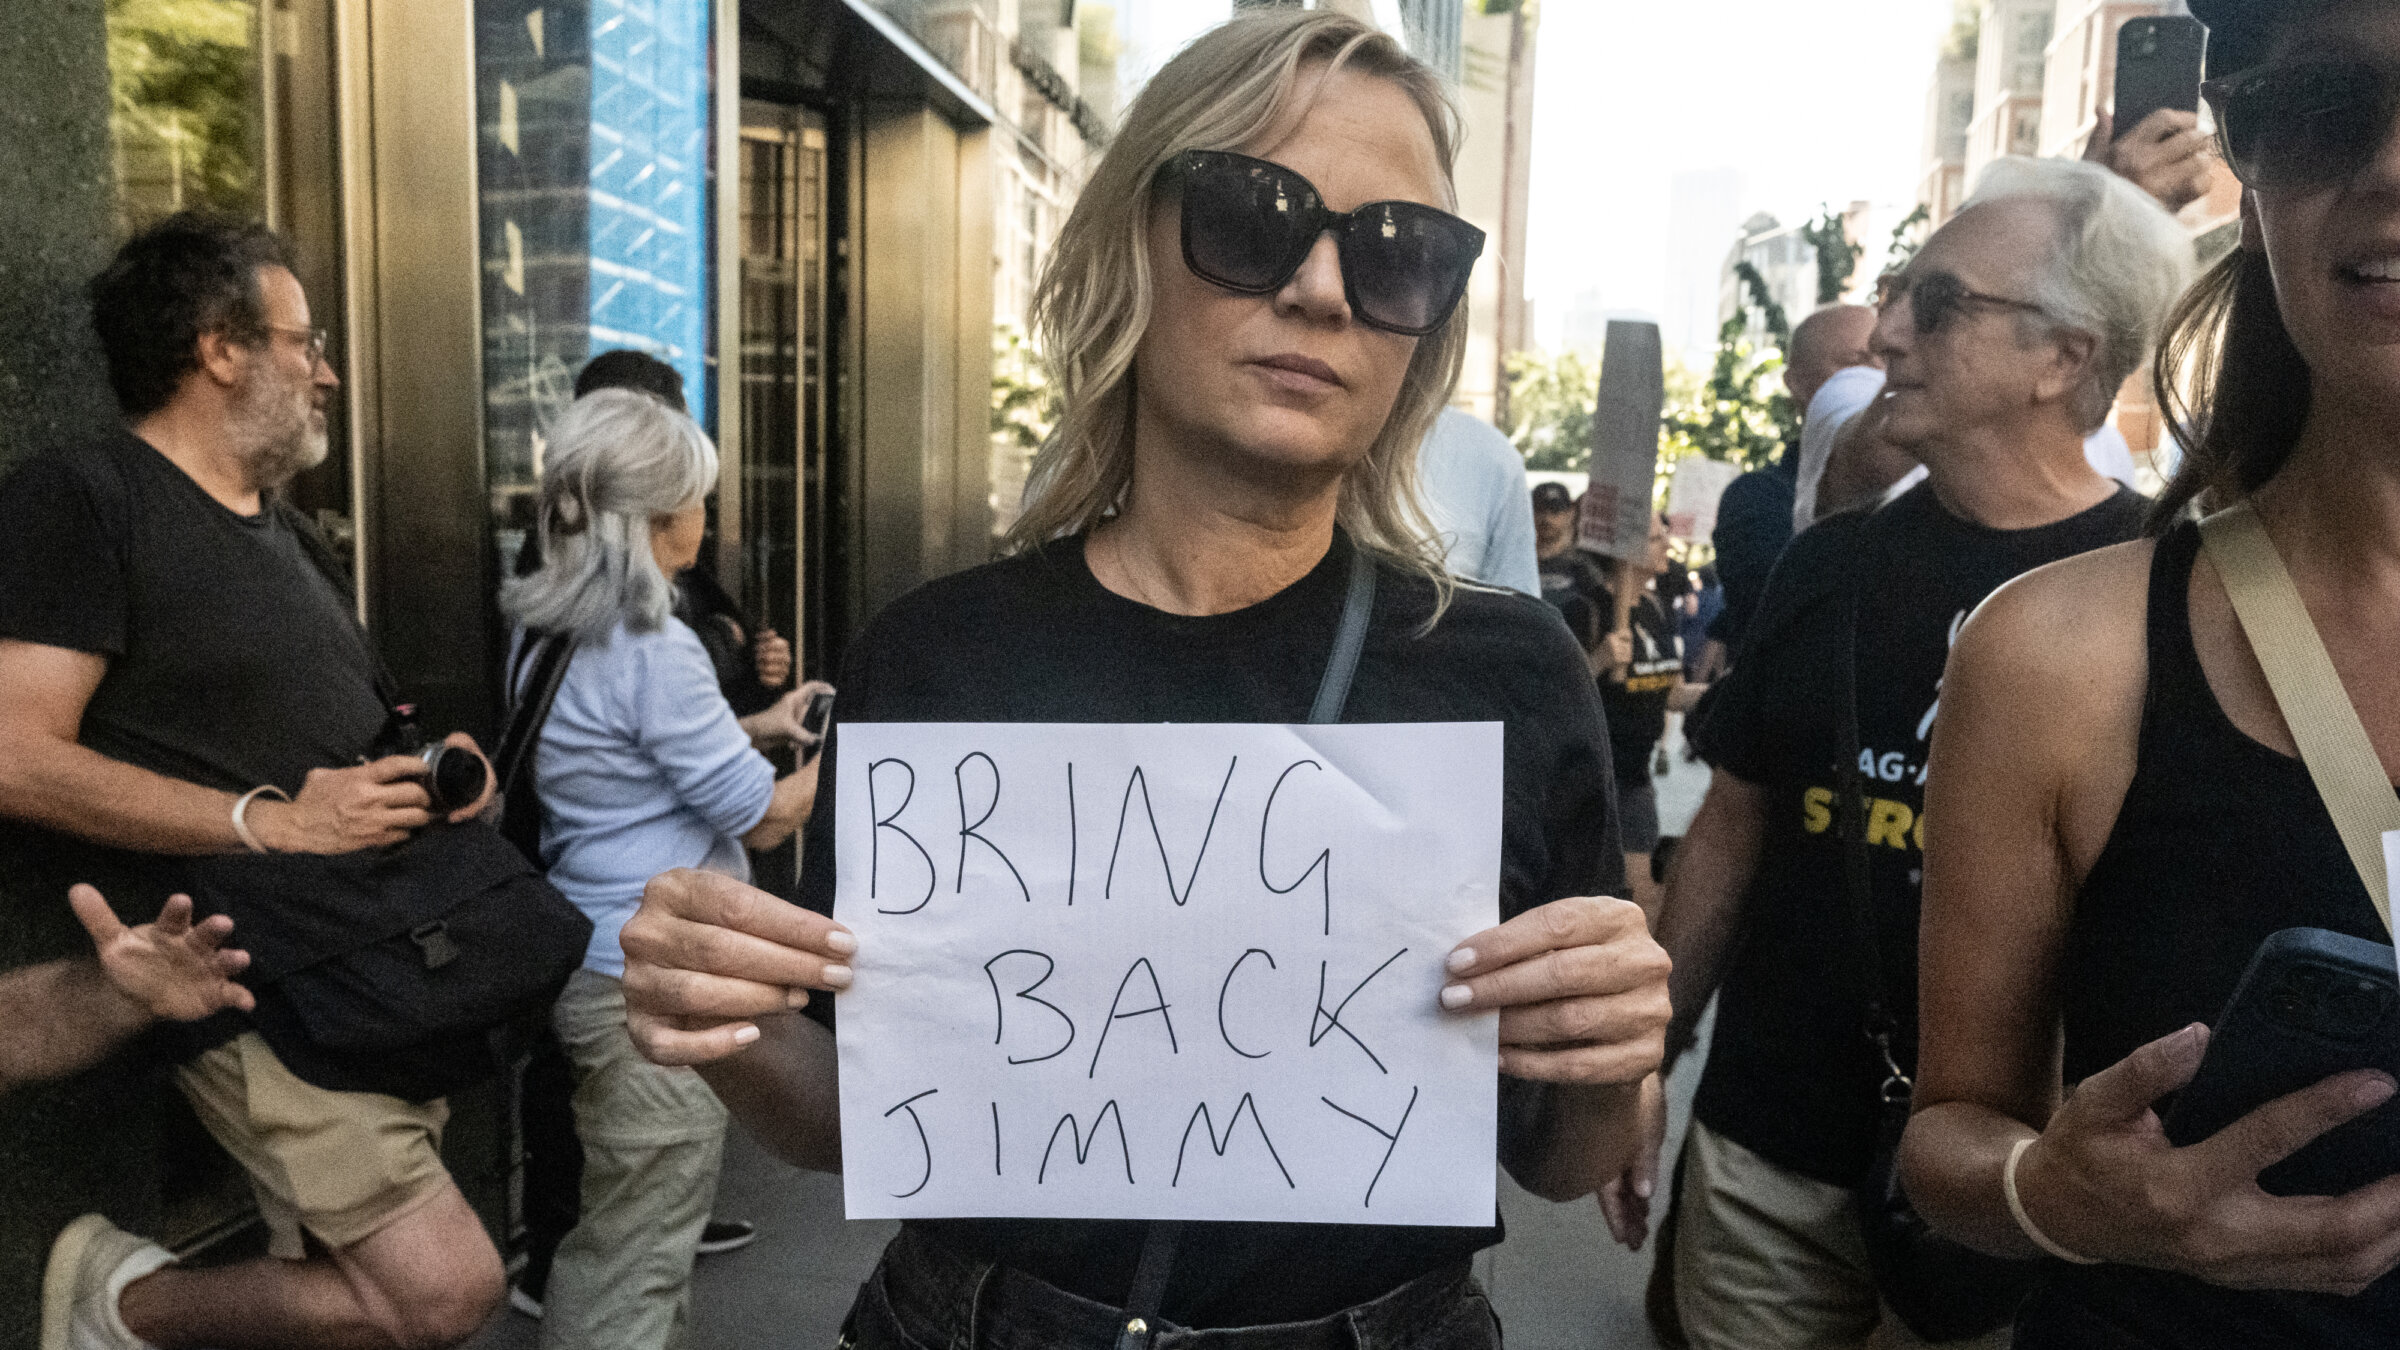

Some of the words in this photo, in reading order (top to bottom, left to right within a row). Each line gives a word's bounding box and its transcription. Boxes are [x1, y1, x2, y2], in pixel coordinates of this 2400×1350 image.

[868, 751, 1330, 936] BRING
[983, 947, 1408, 1079] BACK
[884, 1086, 1419, 1208] JIMMY
